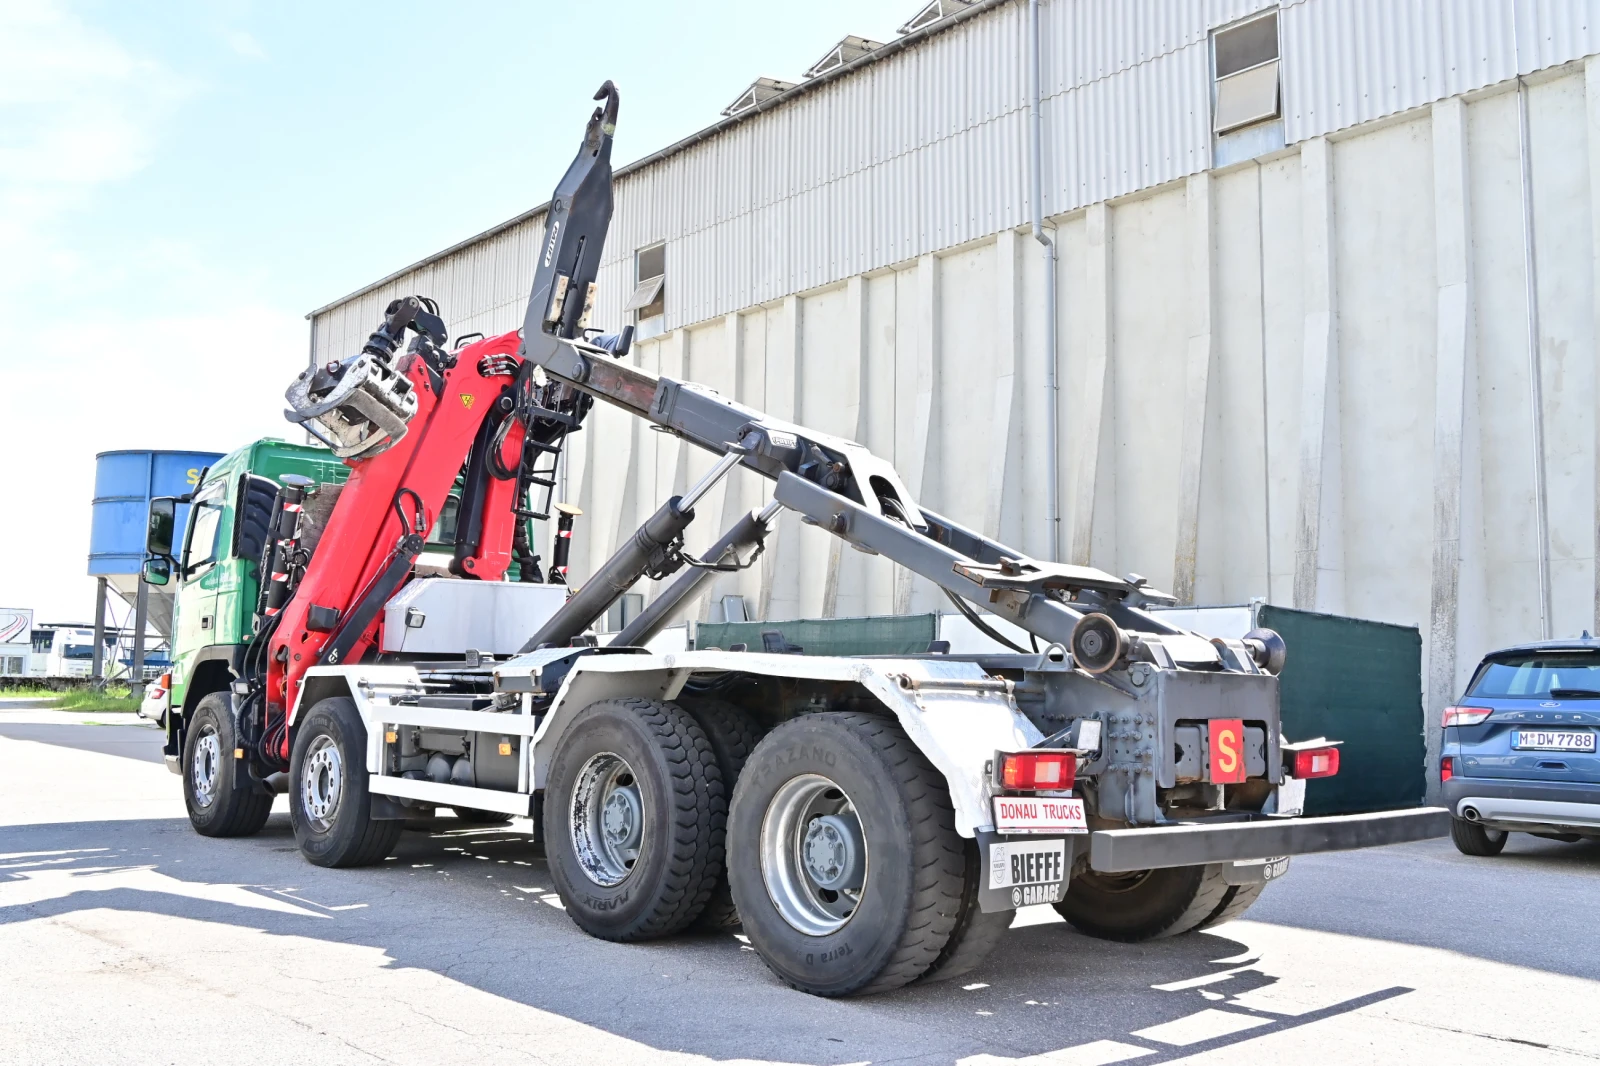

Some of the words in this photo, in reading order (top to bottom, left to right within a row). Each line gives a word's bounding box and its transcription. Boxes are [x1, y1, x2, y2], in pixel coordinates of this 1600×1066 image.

[1519, 733, 1529, 745] M
[1537, 733, 1555, 746] DW
[1557, 734, 1592, 747] 7788
[1218, 729, 1237, 773] S
[1000, 803, 1037, 819] DONAU
[1043, 804, 1082, 820] TRUCKS
[1010, 851, 1062, 884] BIEFFE
[1023, 884, 1060, 905] GARAGE
[805, 953, 814, 966] D
[820, 942, 854, 963] Terra
